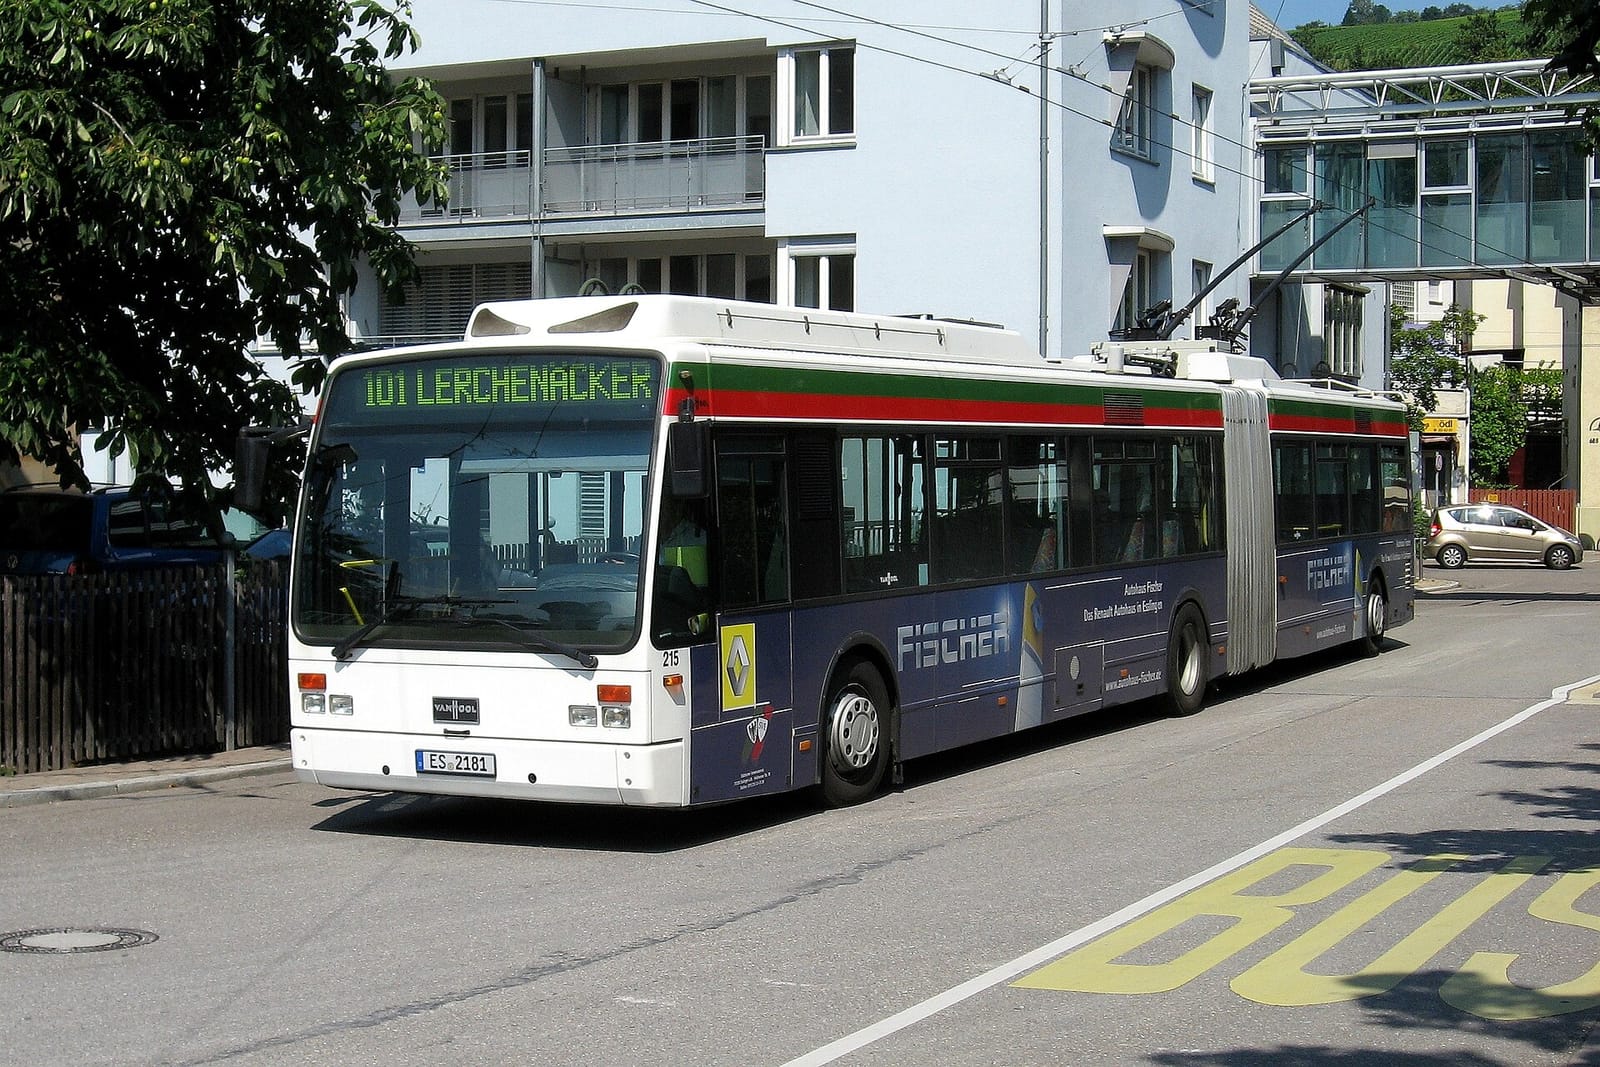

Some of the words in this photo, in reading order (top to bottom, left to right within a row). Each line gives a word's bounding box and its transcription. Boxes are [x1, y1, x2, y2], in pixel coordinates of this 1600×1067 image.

[364, 370, 407, 405] 101
[1124, 583, 1146, 596] Autohaus
[1147, 580, 1163, 593] Fischer
[1094, 605, 1113, 620] Renault
[1114, 603, 1136, 617] Autohaus
[897, 613, 1010, 671] FISCHER
[663, 651, 679, 667] 215
[430, 753, 447, 769] ES
[455, 755, 488, 772] 2181
[1009, 847, 1600, 1021] BUS
